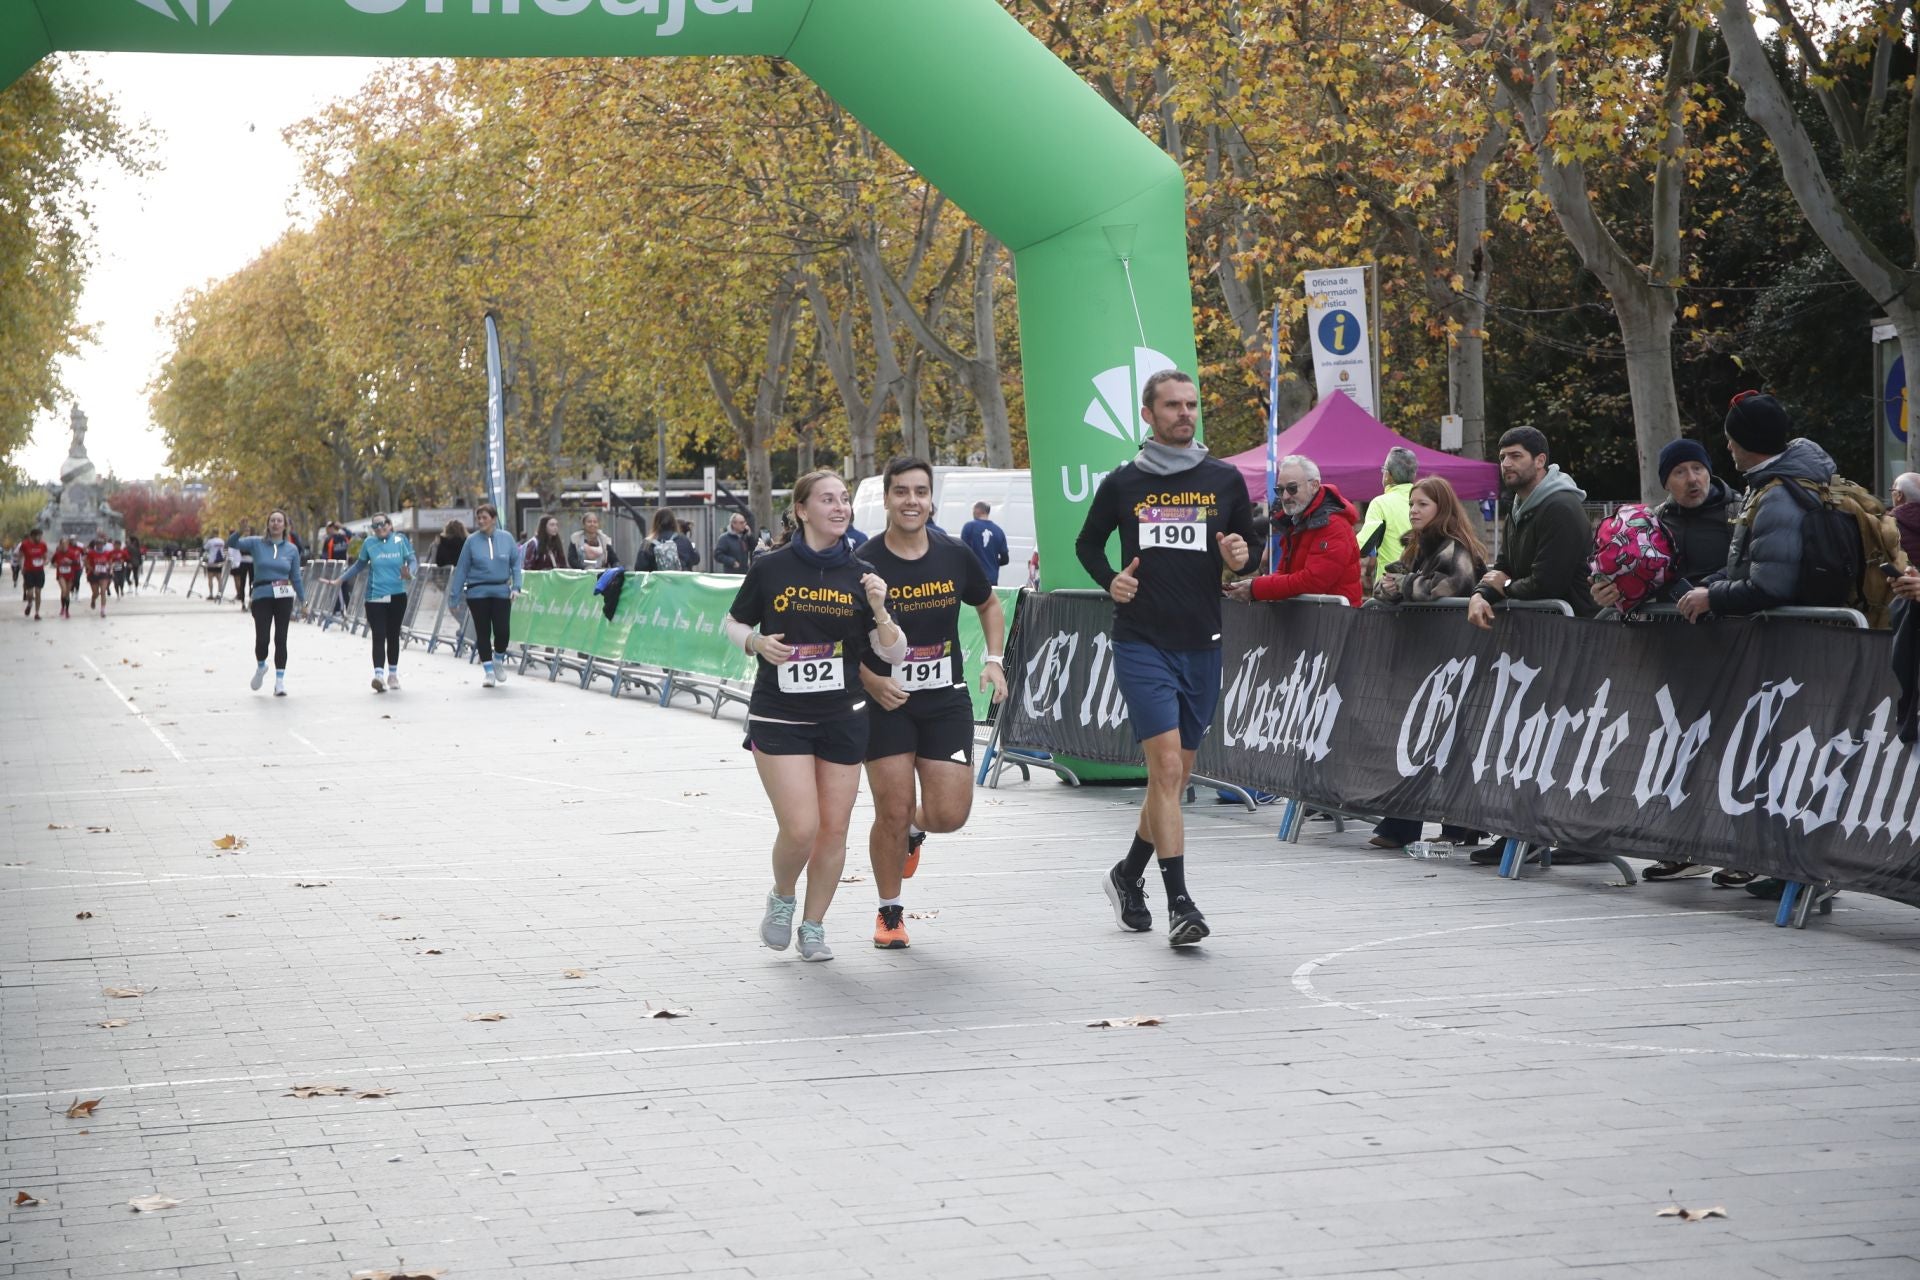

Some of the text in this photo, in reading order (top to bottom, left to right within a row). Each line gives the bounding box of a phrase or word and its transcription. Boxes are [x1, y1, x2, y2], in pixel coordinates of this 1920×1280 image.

[1312, 276, 1348, 287] Oficina de
[1160, 492, 1216, 505] CellMat
[1149, 525, 1196, 544] 190
[799, 587, 853, 605] CellMat
[902, 580, 955, 599] CellMat
[791, 601, 854, 617] Technologies
[898, 596, 957, 612] Technologies
[787, 662, 834, 683] 192
[902, 661, 941, 681] 191
[1024, 630, 1078, 721] El
[1397, 655, 1476, 777] El
[1472, 652, 1629, 803] Norte
[1632, 684, 1712, 811] de
